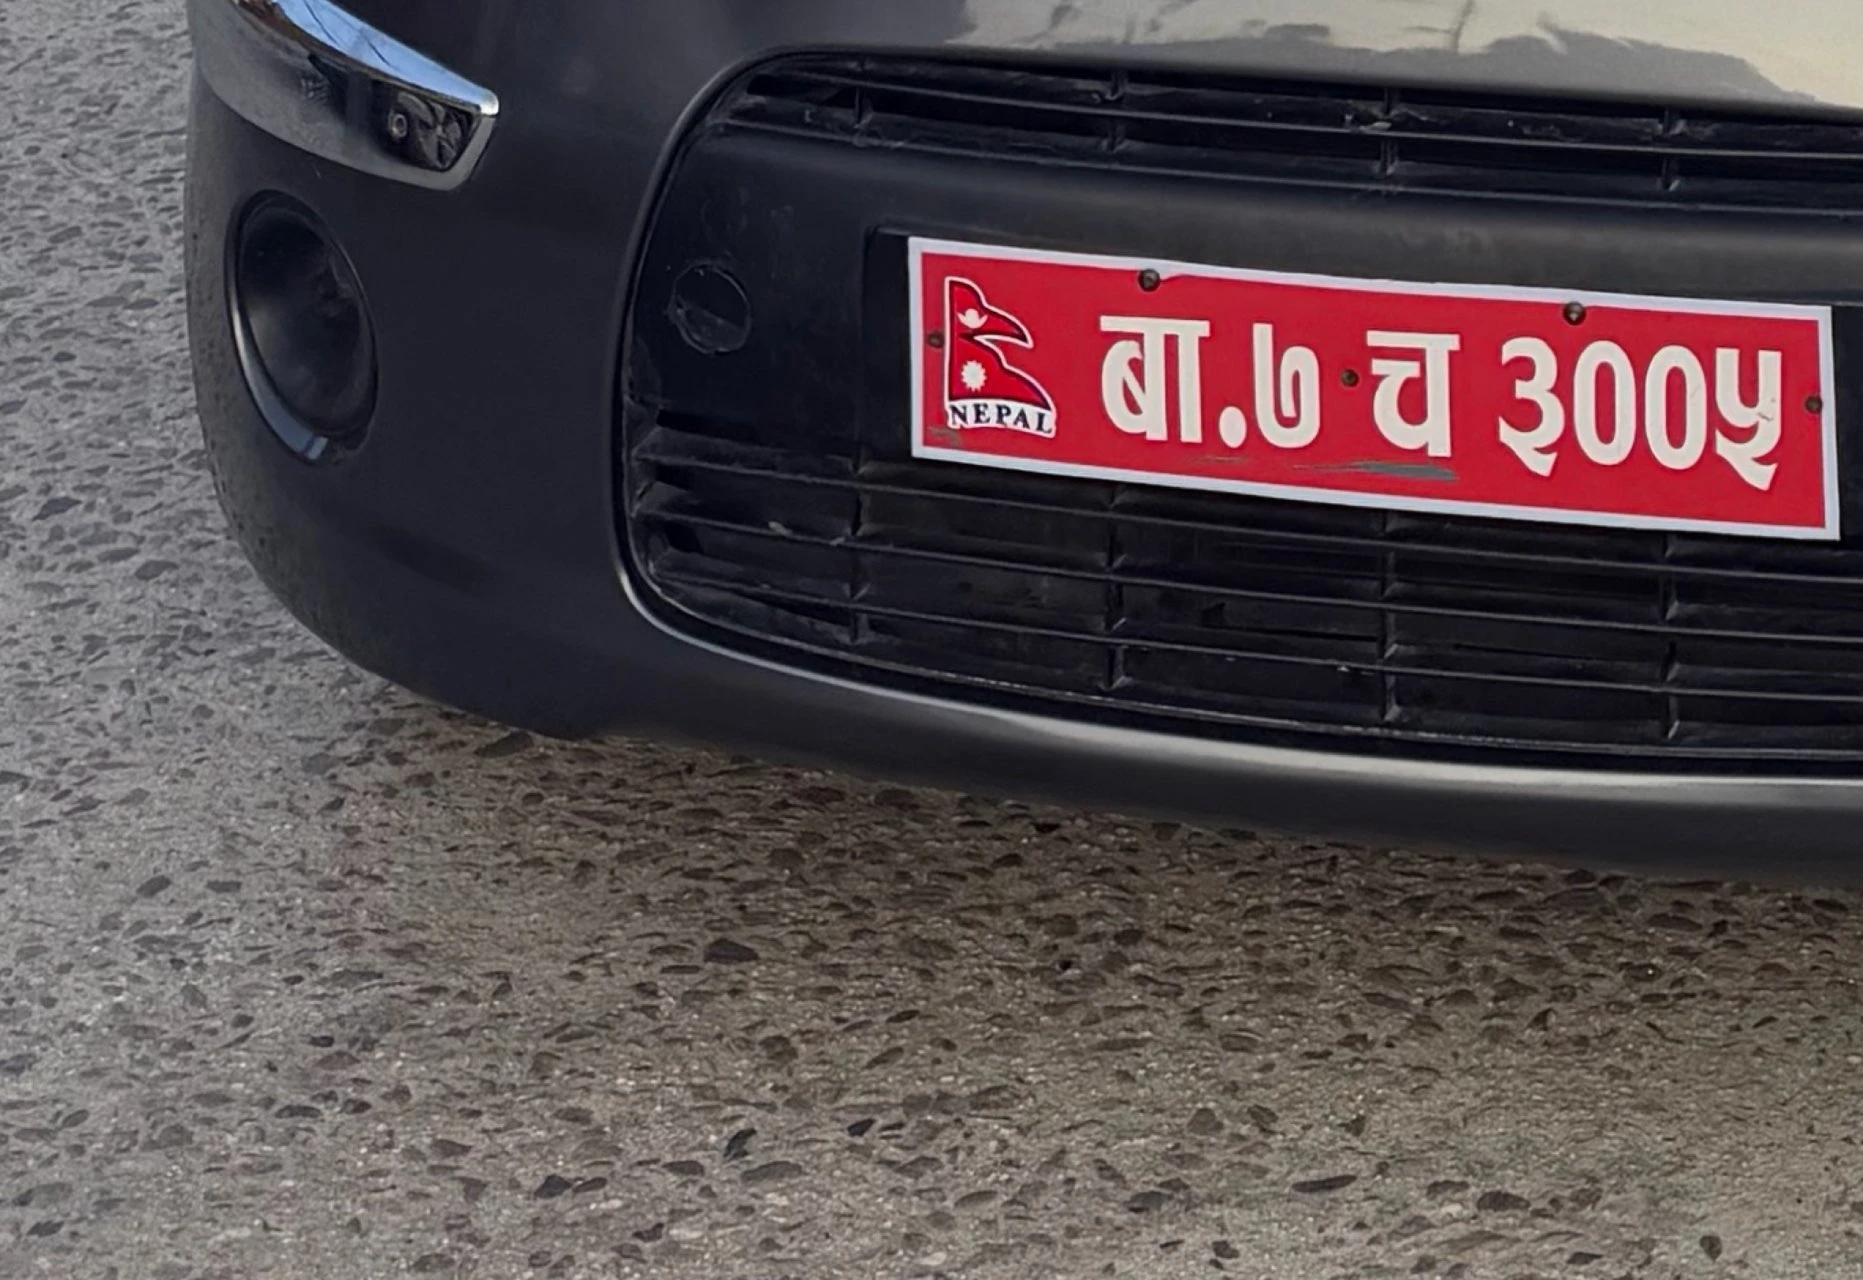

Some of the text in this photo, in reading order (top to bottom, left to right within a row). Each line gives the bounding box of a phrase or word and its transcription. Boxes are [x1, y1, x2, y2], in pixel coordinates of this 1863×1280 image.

[950, 403, 1052, 434] NEPAL
[1366, 330, 1461, 459] च
[1498, 336, 1784, 492] ३००५
